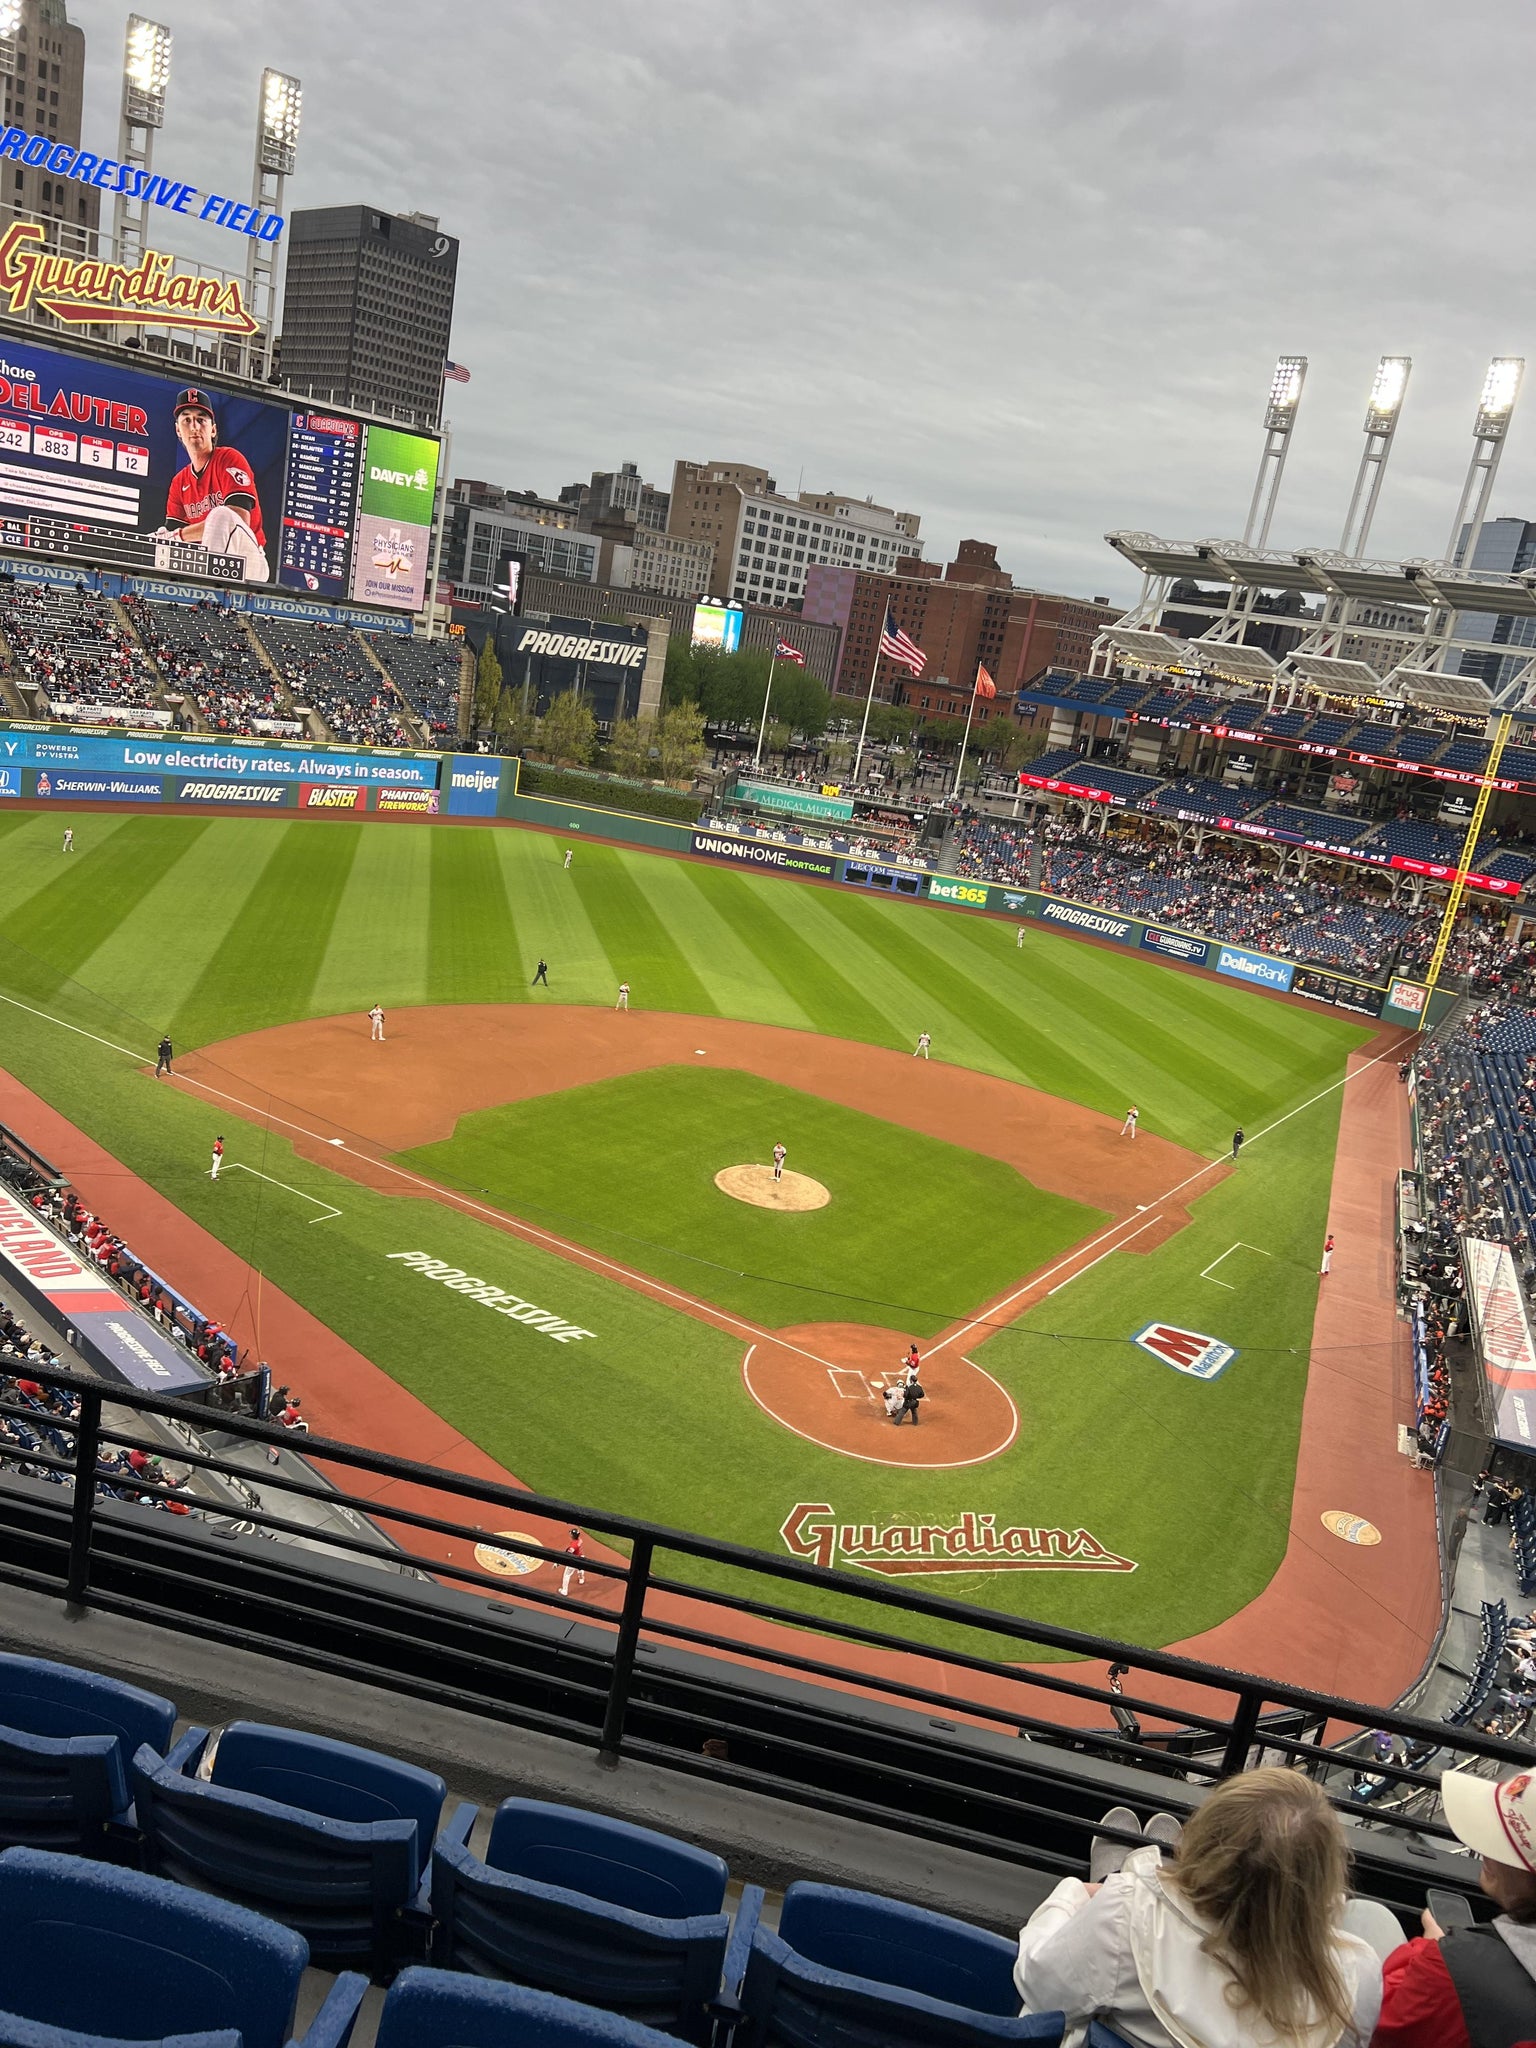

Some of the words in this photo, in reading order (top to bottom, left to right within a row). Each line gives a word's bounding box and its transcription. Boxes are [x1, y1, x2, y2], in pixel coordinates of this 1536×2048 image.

[0, 124, 202, 215] ROGRESSIVE
[199, 194, 286, 243] FIELD
[432, 237, 450, 258] 9
[0, 221, 250, 316] Guardians
[48, 429, 64, 439] OPS
[310, 418, 356, 434] GUARDIANS
[92, 450, 100, 463] 5
[125, 456, 138, 470] 12
[370, 466, 414, 487] DAVEY
[7, 522, 21, 532] BAL
[306, 523, 330, 532] DELAUTER
[6, 536, 20, 545] CLE
[373, 538, 414, 552] PHYSICIANS
[11, 562, 89, 584] HONDA
[150, 584, 219, 600] HONDA
[365, 580, 378, 588] JOIN
[379, 582, 390, 590] OUR
[391, 584, 414, 594] MISSION
[270, 600, 331, 617] HONDA
[350, 612, 406, 628] HONDA
[517, 629, 647, 668] PROGRESSIVE
[9, 722, 51, 732] PROGRESSIVE
[69, 727, 111, 736] PROGRESSIVE
[126, 731, 164, 740] PROGRESSIVE
[180, 735, 217, 743] PROGRESSIVE
[231, 739, 266, 747] PROGRESSIVE
[36, 744, 78, 752] POWERED
[281, 742, 314, 750] PROGRESSIVE
[50, 752, 79, 760] VISTRA
[124, 748, 161, 765] Low
[165, 750, 248, 773] electricity
[251, 759, 295, 773] rates.
[298, 759, 351, 780] Always
[355, 763, 368, 777] in
[371, 766, 424, 781] season.
[452, 771, 500, 793] meijer
[180, 783, 286, 802] PROGRESSIVE
[307, 788, 359, 807] BLASTER
[381, 790, 429, 801] PHANTOM
[379, 801, 427, 811] FIREWORKS
[761, 795, 803, 811] MEDICAL
[805, 803, 846, 819] MUTUAL
[785, 859, 831, 874] MORTGAGE
[850, 862, 886, 875] LECOM
[930, 880, 988, 904] bet365
[1043, 903, 1131, 937] PROGRESSIVE
[1220, 952, 1288, 984] DollarBank
[1395, 984, 1419, 1001] drug
[1394, 997, 1421, 1010] mart
[0, 1196, 82, 1279] ELAND
[385, 1251, 598, 1343] PROGRESSIVE
[1143, 1326, 1210, 1367] M
[1192, 1344, 1227, 1375] Marathon
[780, 1502, 1118, 1569] Guardians
